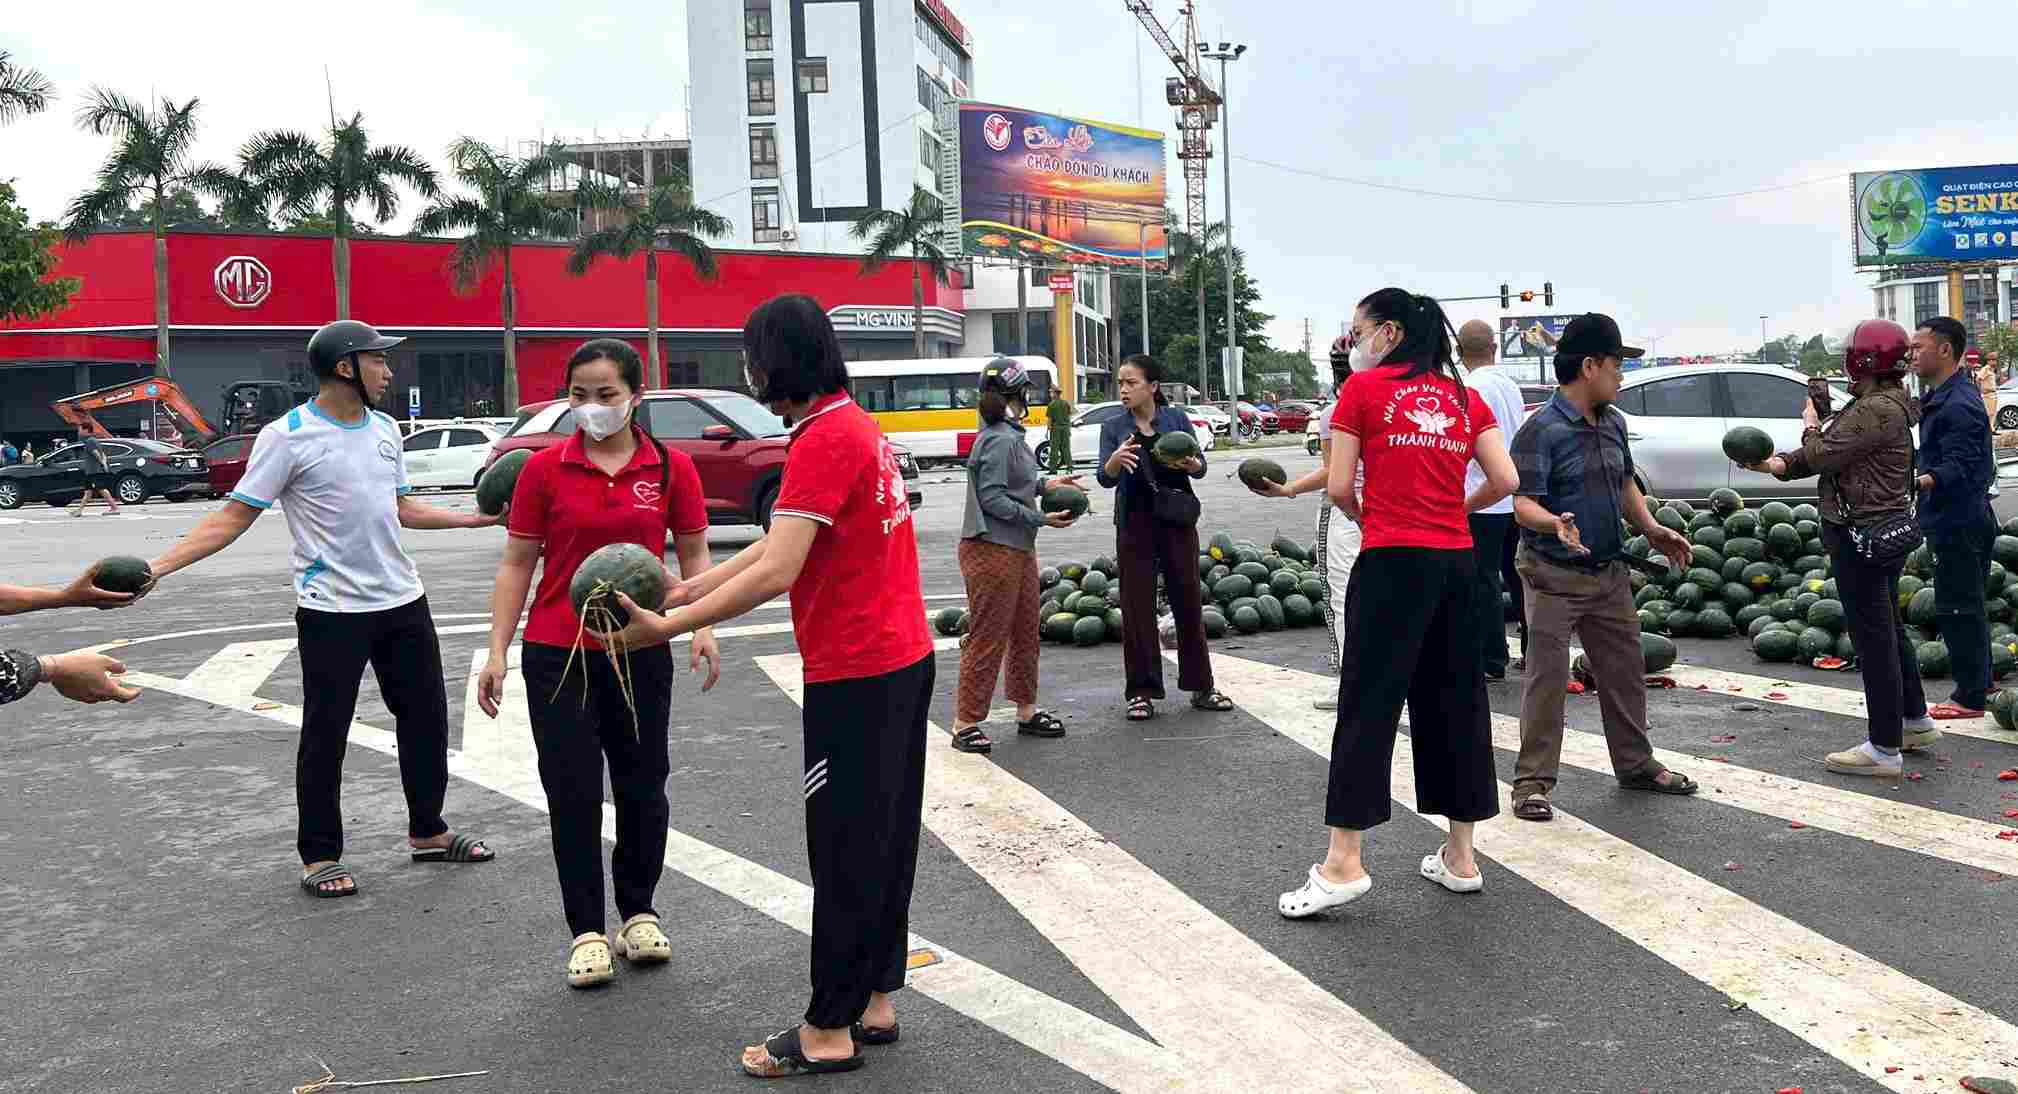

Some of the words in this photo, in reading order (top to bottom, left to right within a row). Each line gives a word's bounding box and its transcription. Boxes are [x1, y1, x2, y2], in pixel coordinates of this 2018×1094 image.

[1093, 162, 1108, 178] DU
[222, 261, 265, 302] MG
[856, 311, 880, 327] MG
